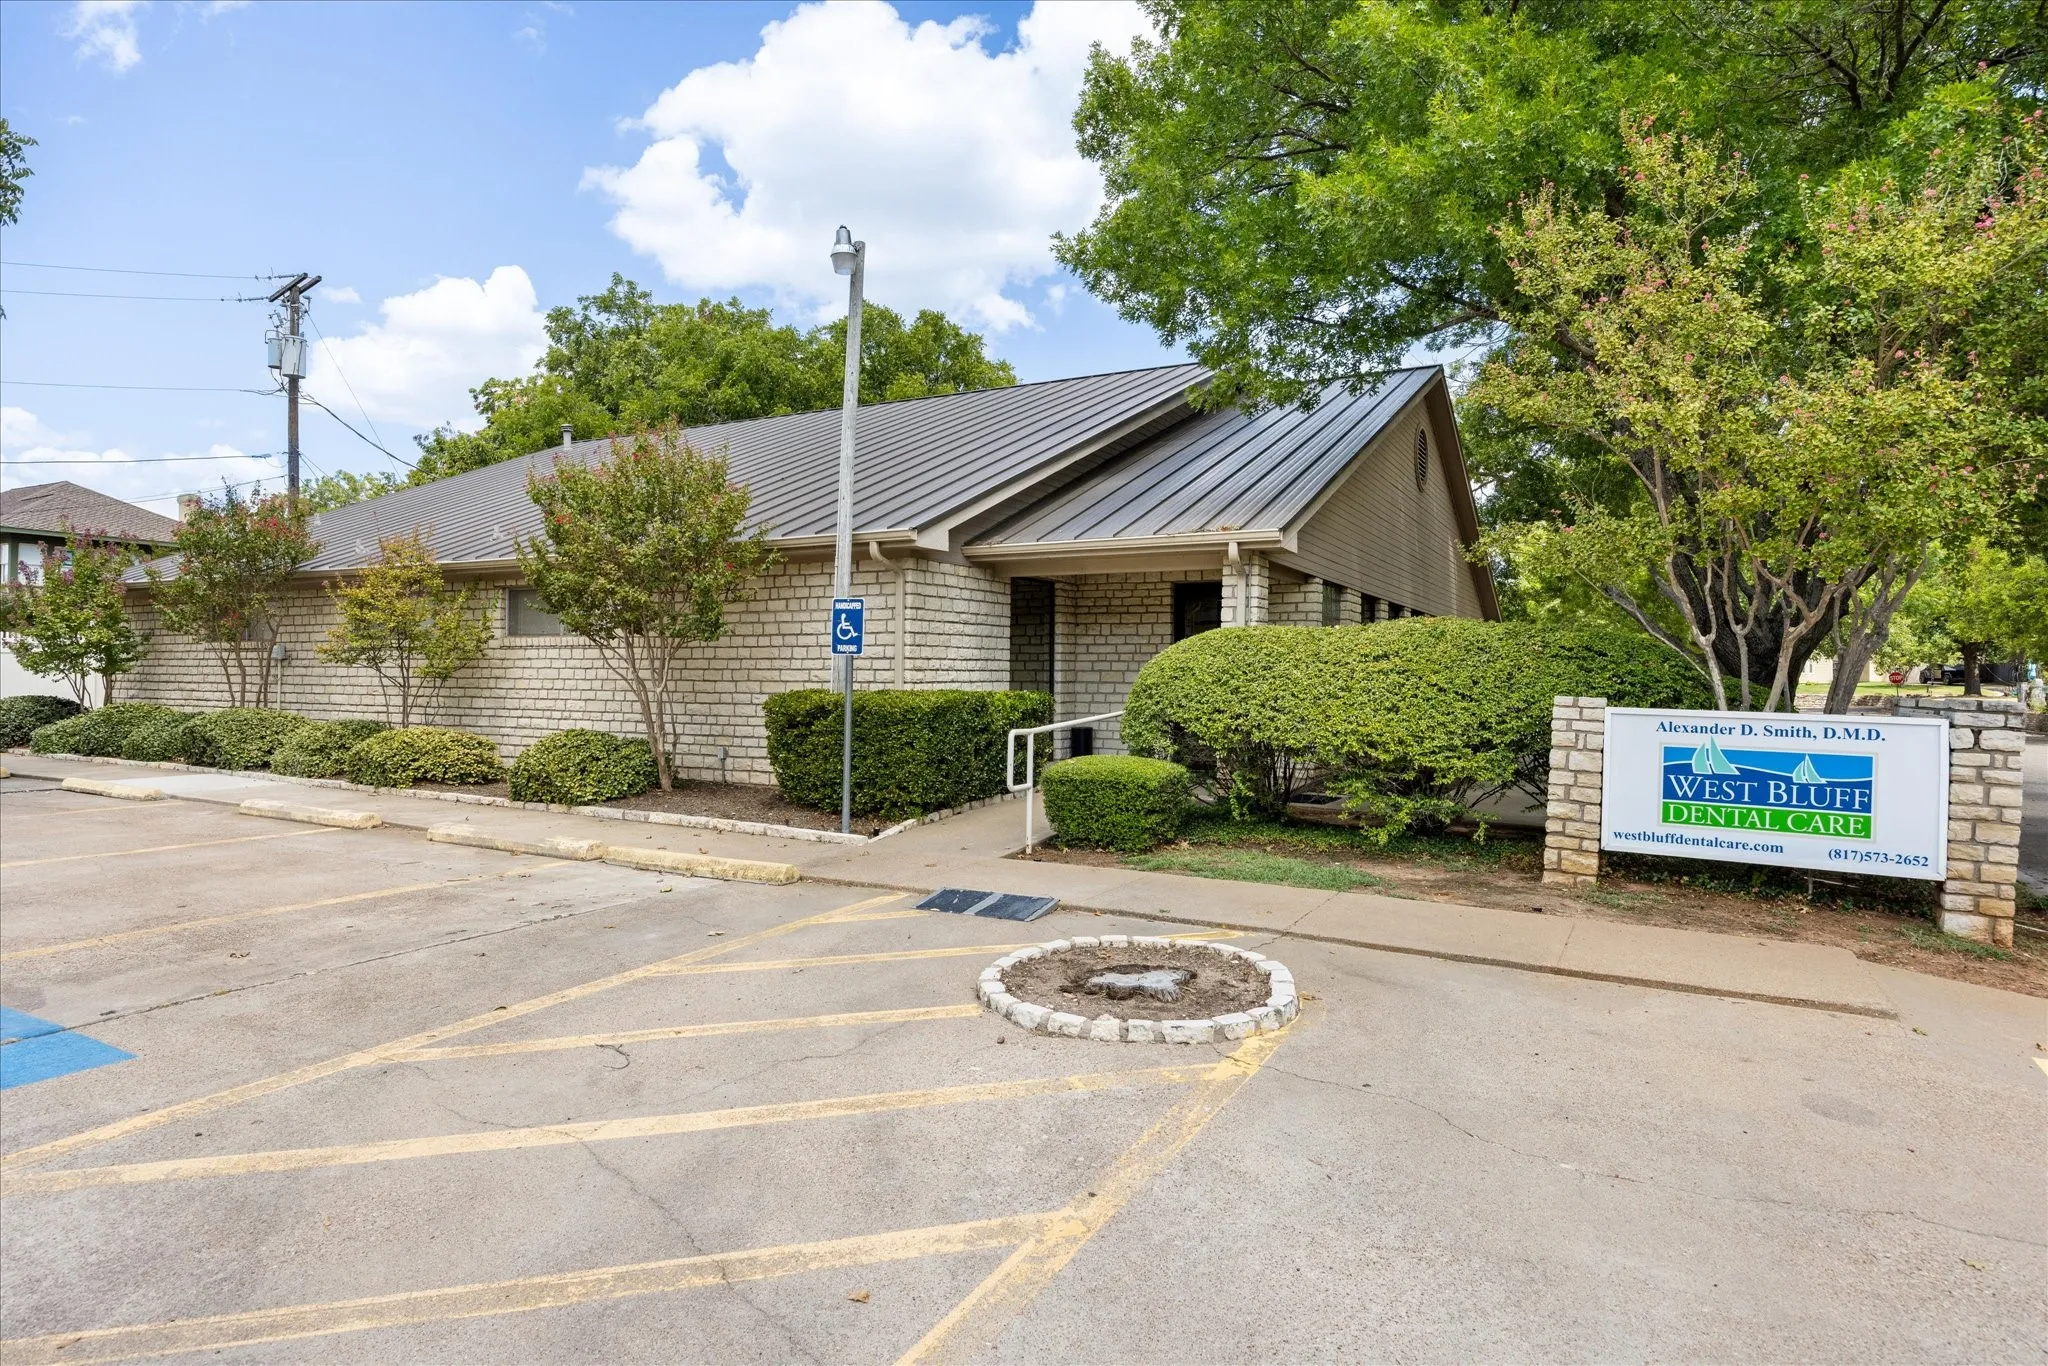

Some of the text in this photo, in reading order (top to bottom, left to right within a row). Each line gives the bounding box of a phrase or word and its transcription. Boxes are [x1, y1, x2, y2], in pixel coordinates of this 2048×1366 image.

[837, 644, 857, 652] PARKING
[1656, 721, 1886, 742] Alexander D. Smith, D.M.D.
[1667, 774, 1869, 810] WEST BLUFF
[1668, 804, 1865, 836] DENTAL CARE
[1613, 831, 1784, 854] westbluffdentalcare.com
[1828, 848, 1929, 867] (817)573-2652
